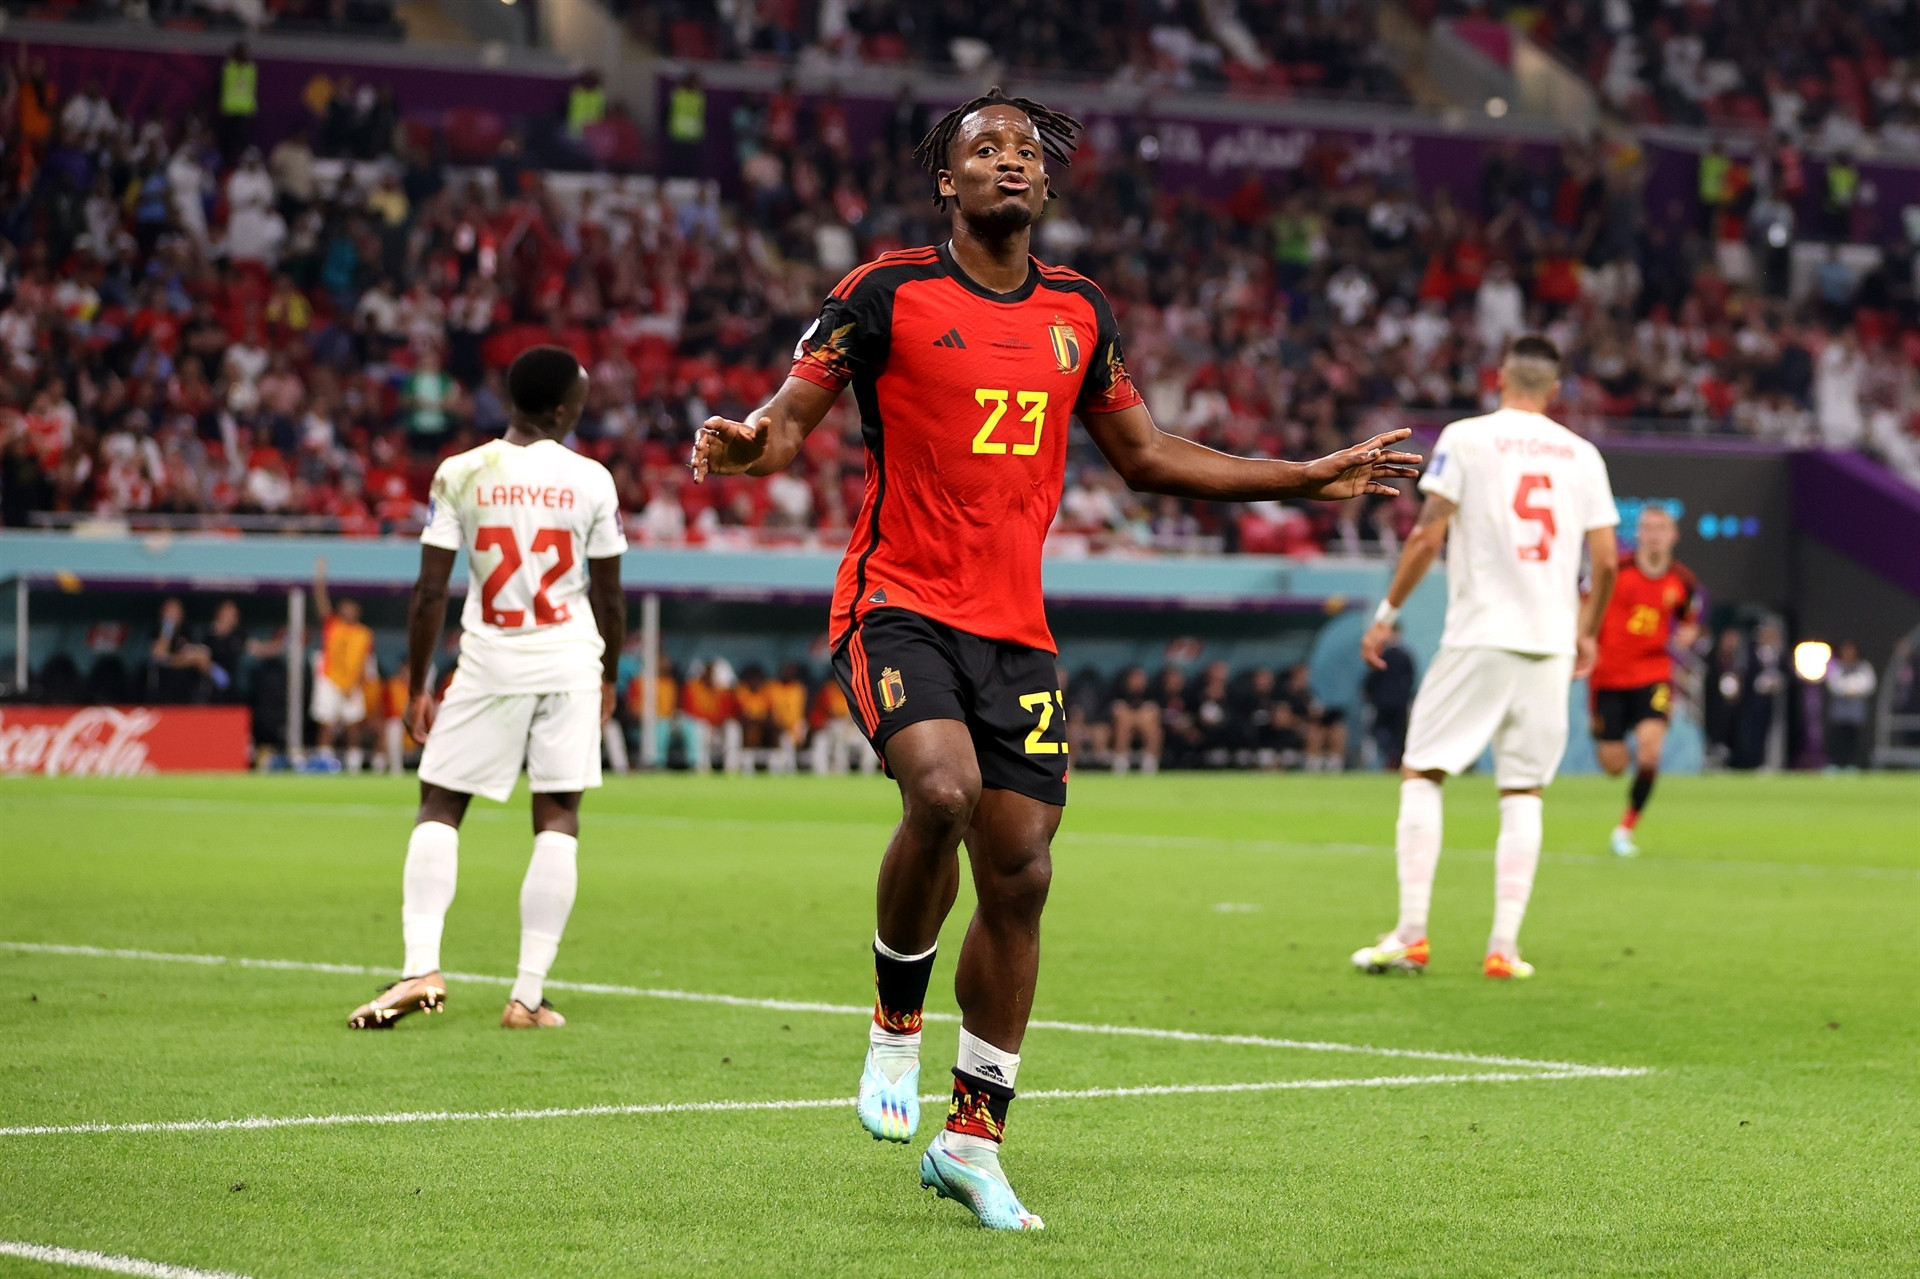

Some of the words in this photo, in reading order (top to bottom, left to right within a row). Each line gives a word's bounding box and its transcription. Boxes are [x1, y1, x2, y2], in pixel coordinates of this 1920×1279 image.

[972, 388, 1048, 456] 23
[475, 485, 574, 509] LARYEA
[1513, 474, 1557, 562] 5
[475, 526, 575, 628] 22
[975, 1066, 1009, 1085] adidas
